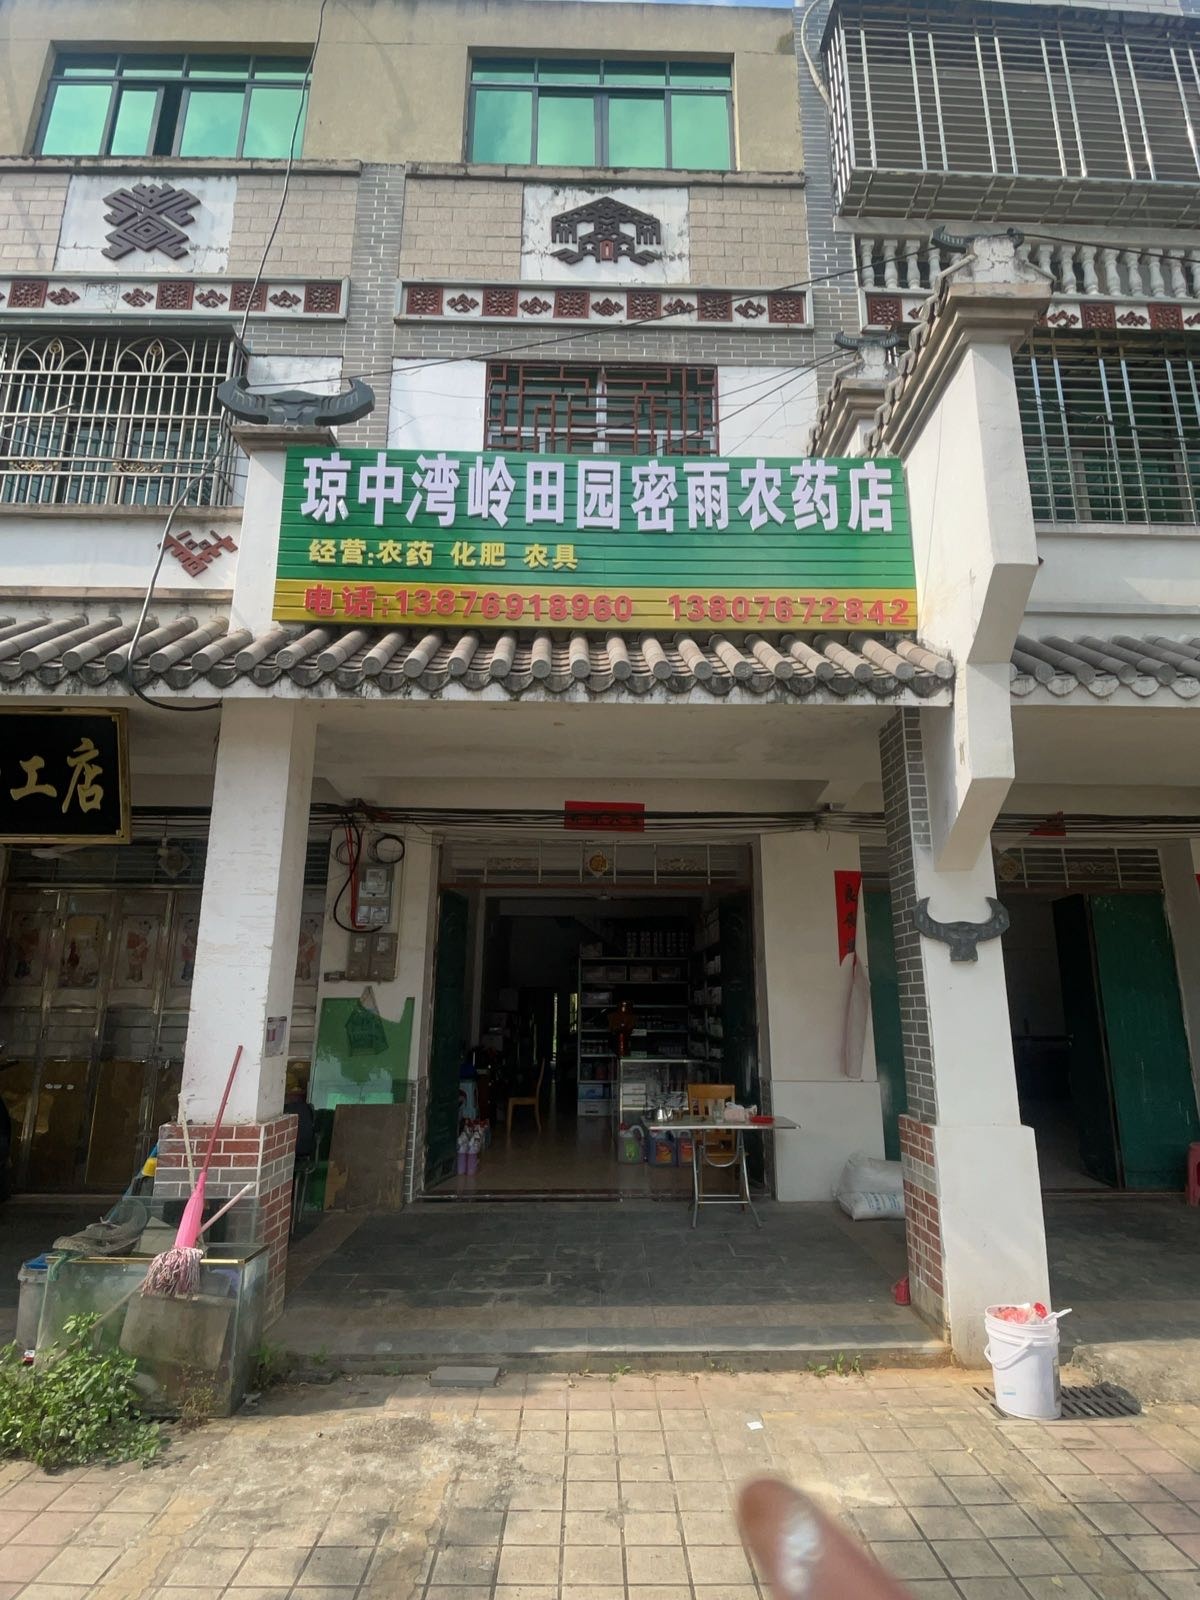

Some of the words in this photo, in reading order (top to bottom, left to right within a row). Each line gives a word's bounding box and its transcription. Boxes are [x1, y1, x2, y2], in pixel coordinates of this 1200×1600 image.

[300, 451, 893, 533] 琼中湾岭田园密雨农药店
[450, 541, 507, 568] 化肥
[522, 543, 579, 571] 农具
[666, 593, 911, 626] 13807672842
[9, 736, 104, 814] 工店
